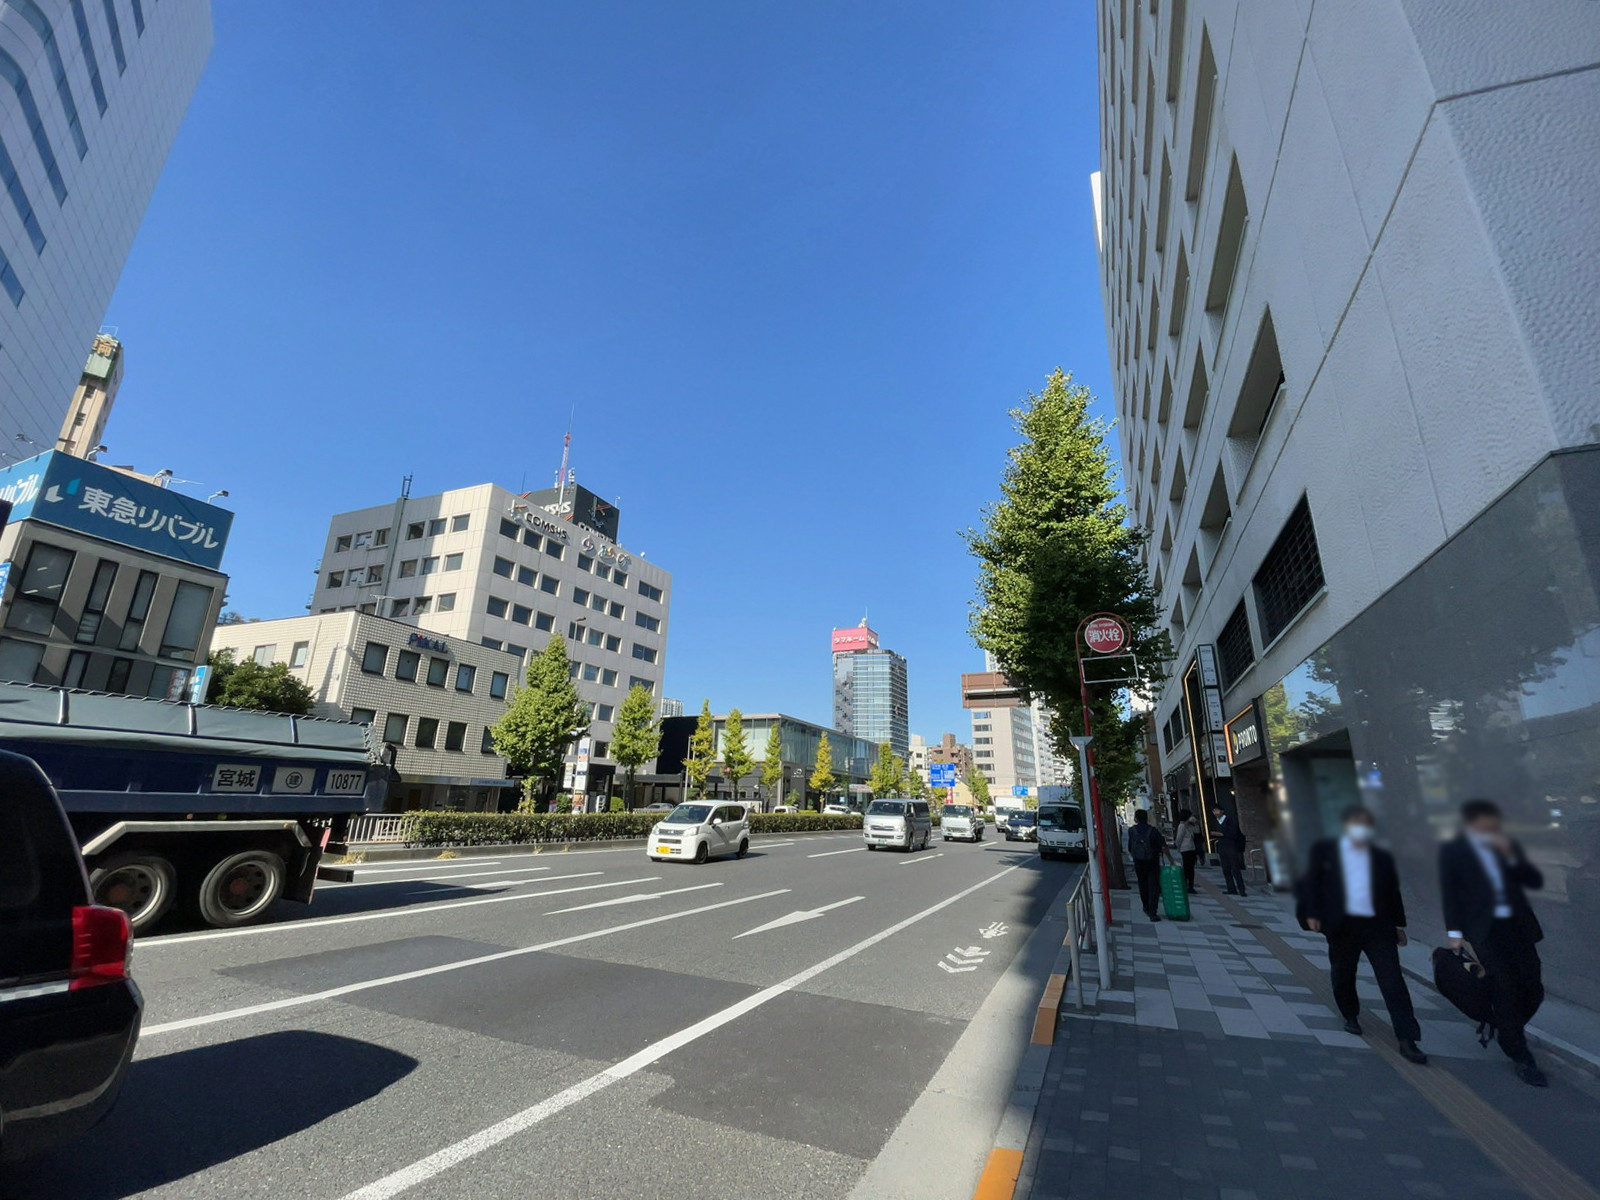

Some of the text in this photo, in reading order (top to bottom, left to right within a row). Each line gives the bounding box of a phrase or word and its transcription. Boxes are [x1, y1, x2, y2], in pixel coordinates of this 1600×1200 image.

[78, 486, 219, 549] 東急リバブル
[538, 500, 572, 518] MSYS
[525, 512, 567, 540] COMSYS
[1088, 628, 1120, 643] 消火栓
[1237, 724, 1258, 751] PRONTO
[217, 769, 361, 790] 宮城 建 10877
